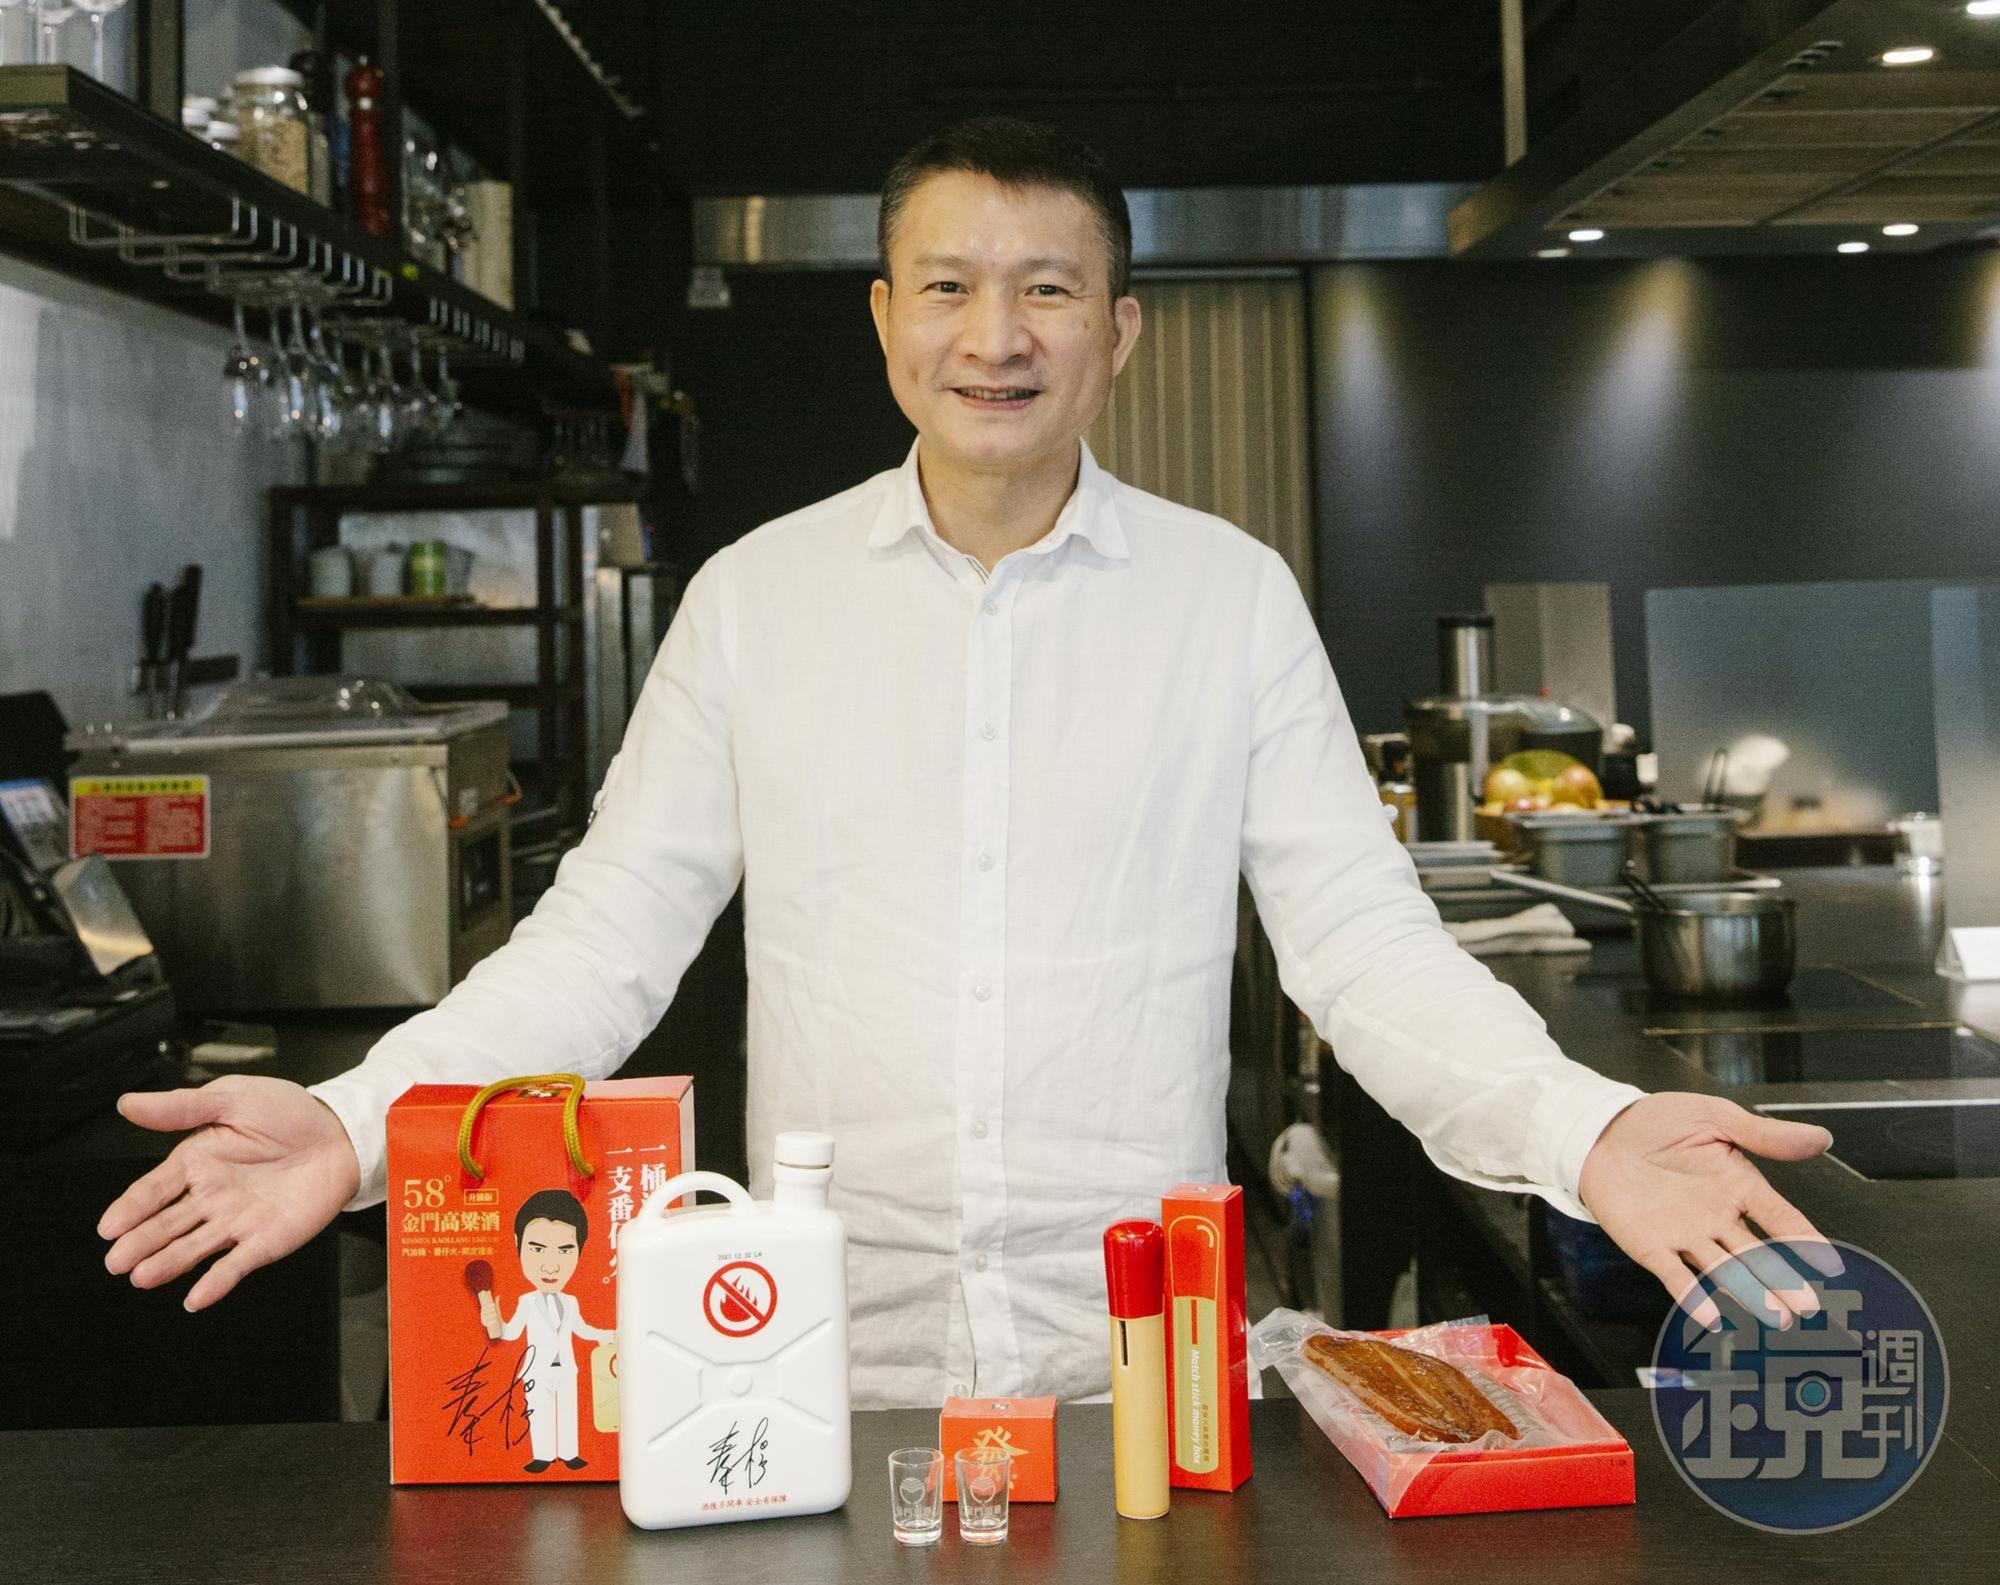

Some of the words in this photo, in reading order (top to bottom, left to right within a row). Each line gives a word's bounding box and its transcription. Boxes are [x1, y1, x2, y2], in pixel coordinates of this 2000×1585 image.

[639, 1144, 667, 1204] 一桶
[402, 1210, 500, 1233] 金門高粱酒
[1190, 1349, 1200, 1381] Match
[1191, 1383, 1201, 1407] stick
[1190, 1408, 1201, 1443] money
[1192, 1445, 1202, 1465] box
